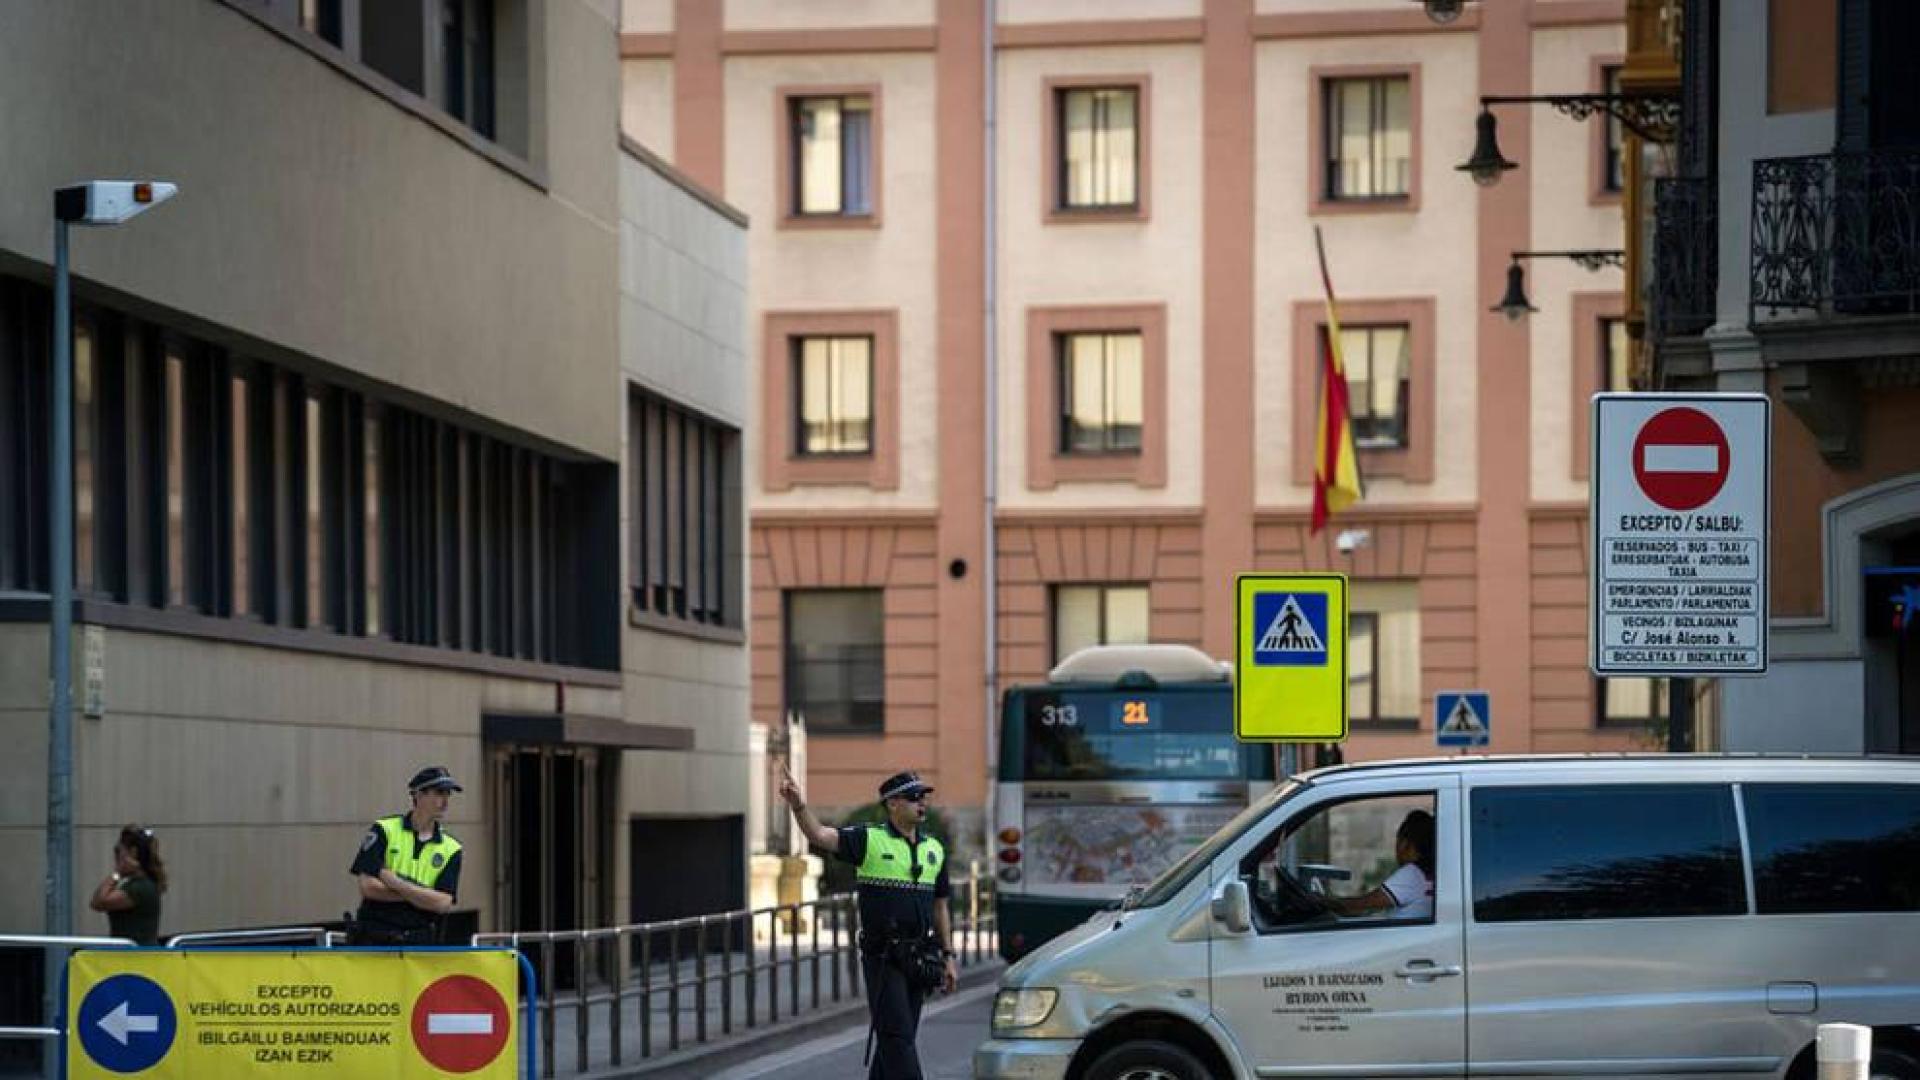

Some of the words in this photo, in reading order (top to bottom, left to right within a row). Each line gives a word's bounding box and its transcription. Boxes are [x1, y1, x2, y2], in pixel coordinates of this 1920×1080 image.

[1620, 515, 1682, 531] EXCEPTO
[1613, 542, 1678, 552] RESERVADOS
[1688, 542, 1708, 553] BUS
[1718, 542, 1741, 552] TAXI
[1611, 554, 1690, 565] ERRESERBATUAK
[1700, 554, 1750, 565] AUTOBUSA
[1668, 566, 1698, 577] TAXIA
[1609, 585, 1678, 596] EMERGENCIAS
[1688, 585, 1752, 596] LARRIALDIAK
[1611, 598, 1674, 609] PARLAMENTO
[1682, 598, 1750, 609] PARLAMENTUA
[1622, 616, 1665, 627] VECINOS
[1675, 616, 1739, 627] BIZILAGUNAK
[1621, 631, 1638, 644] C/
[1644, 630, 1673, 644] José
[1677, 630, 1720, 644] Alonso
[1613, 651, 1676, 662] BICICLETAS
[1687, 651, 1747, 662] BIZIKLETAK
[1041, 705, 1077, 726] 313
[1123, 702, 1149, 725] 21
[257, 984, 334, 999] EXCEPTO
[1285, 992, 1329, 1005] BYRON
[188, 1001, 281, 1016] VEHÍCULOS
[285, 1002, 401, 1016] AUTORIZADOS
[198, 1031, 278, 1045] IBILGAILU
[282, 1031, 392, 1045] BAIMENDUAK
[255, 1050, 292, 1063] IZAN
[296, 1050, 334, 1063] EZIK
